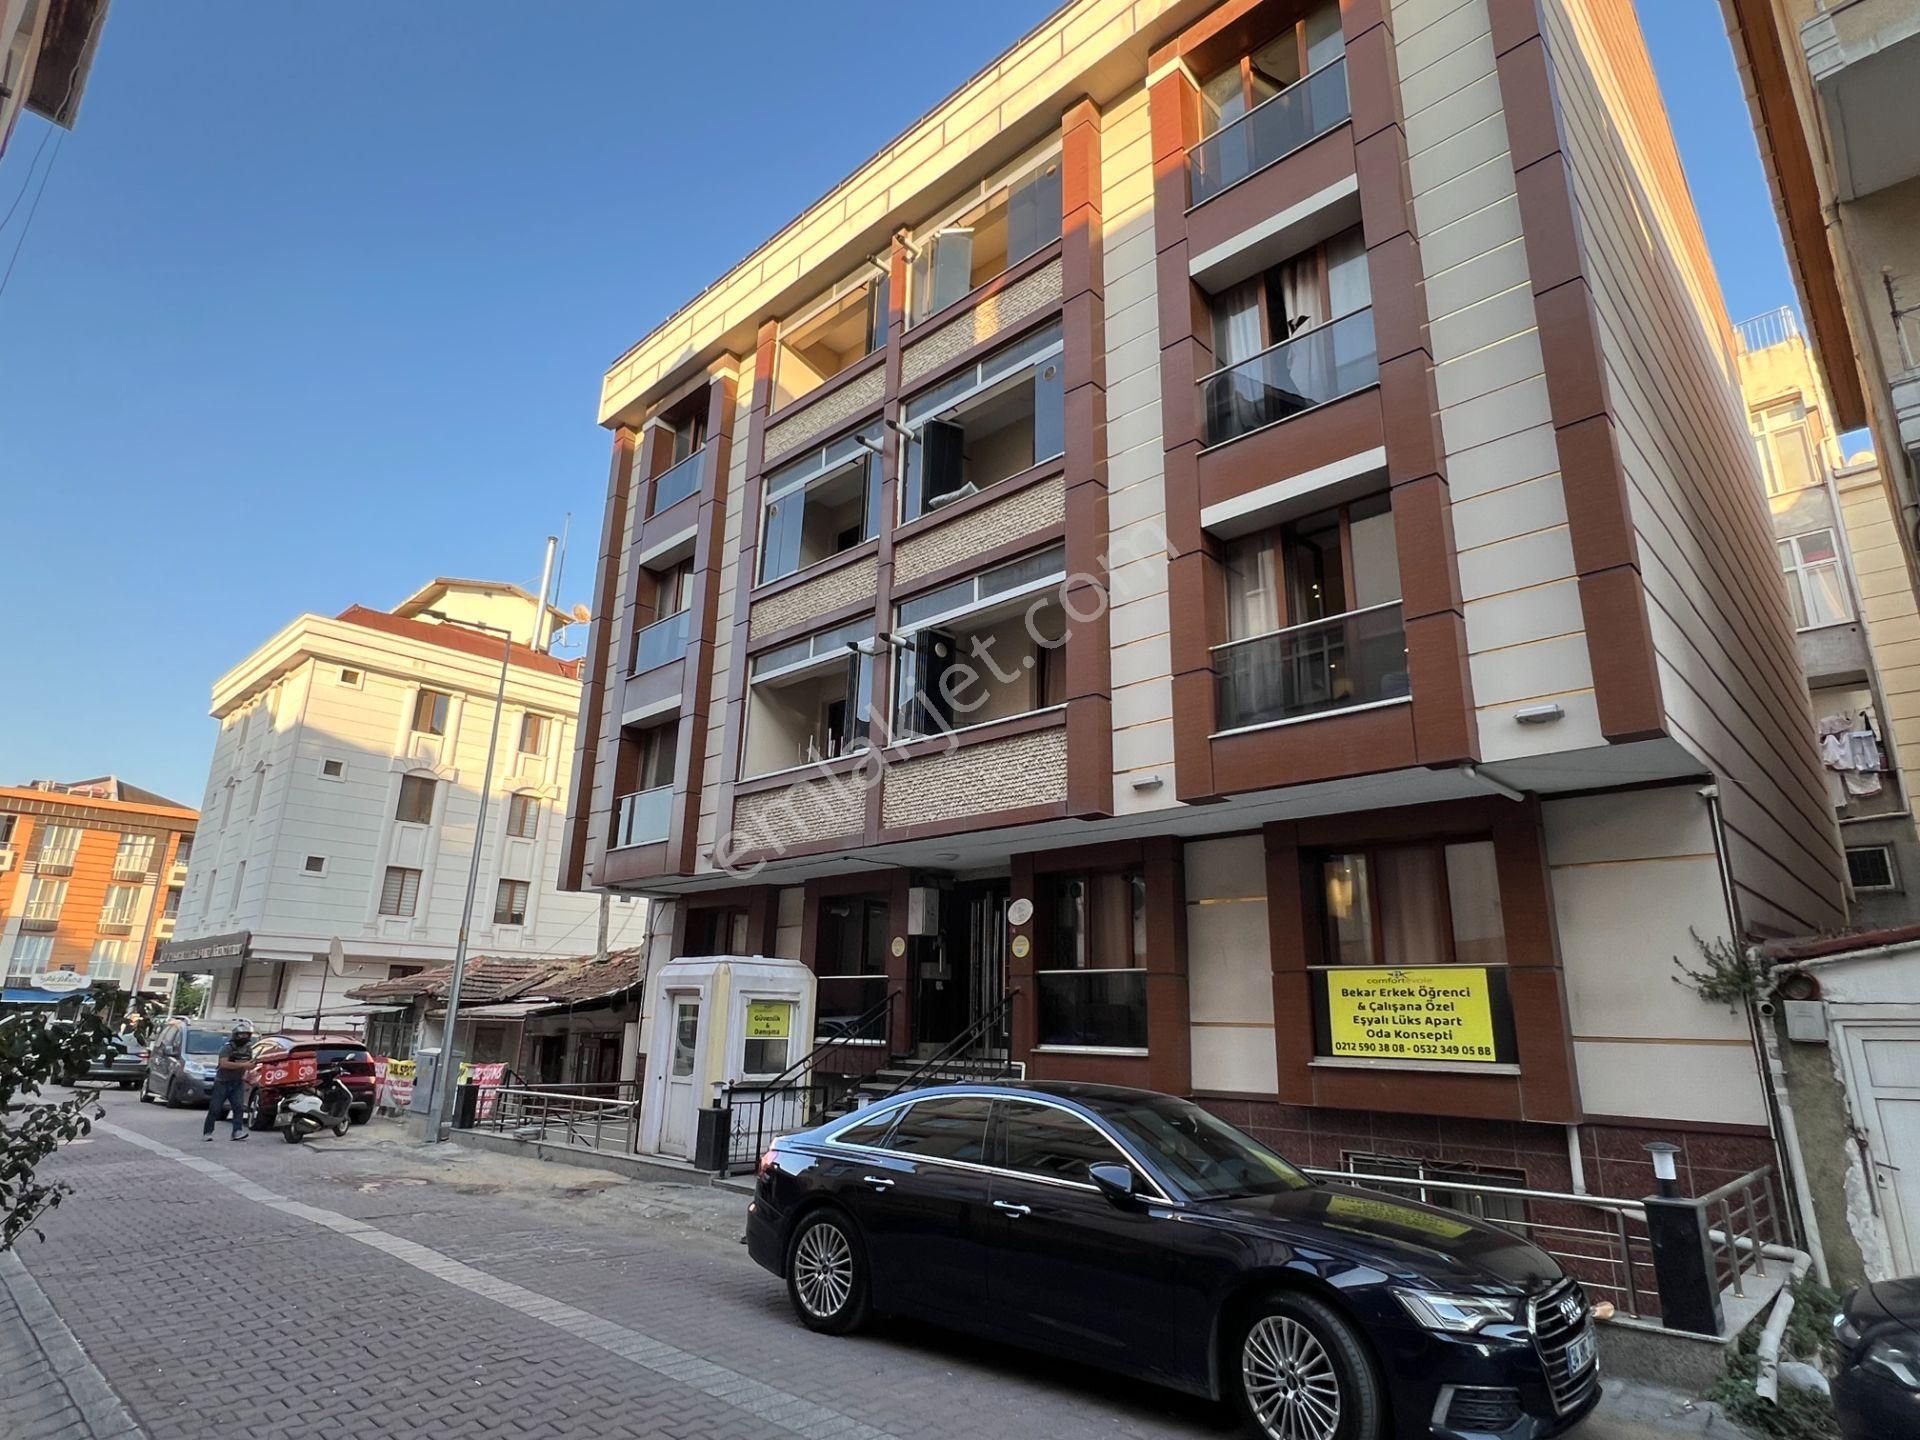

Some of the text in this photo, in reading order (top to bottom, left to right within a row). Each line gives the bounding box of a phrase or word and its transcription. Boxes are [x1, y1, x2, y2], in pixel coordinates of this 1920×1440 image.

[1341, 985, 1471, 1000] Bekar Erkek Öğrenci
[1357, 999, 1455, 1013] & Çalışana Özel
[1353, 1014, 1463, 1028] Eşyalı Lüks Apart
[1366, 1029, 1453, 1042] Oda Konsepti
[1335, 1041, 1357, 1051] 0212
[1358, 1042, 1376, 1052] 590
[1378, 1043, 1390, 1052] 38
[1392, 1043, 1405, 1053] 08
[1413, 1044, 1438, 1054] 0532
[1440, 1045, 1460, 1055] 349
[1461, 1045, 1475, 1056] 05
[1477, 1046, 1491, 1056] 88
